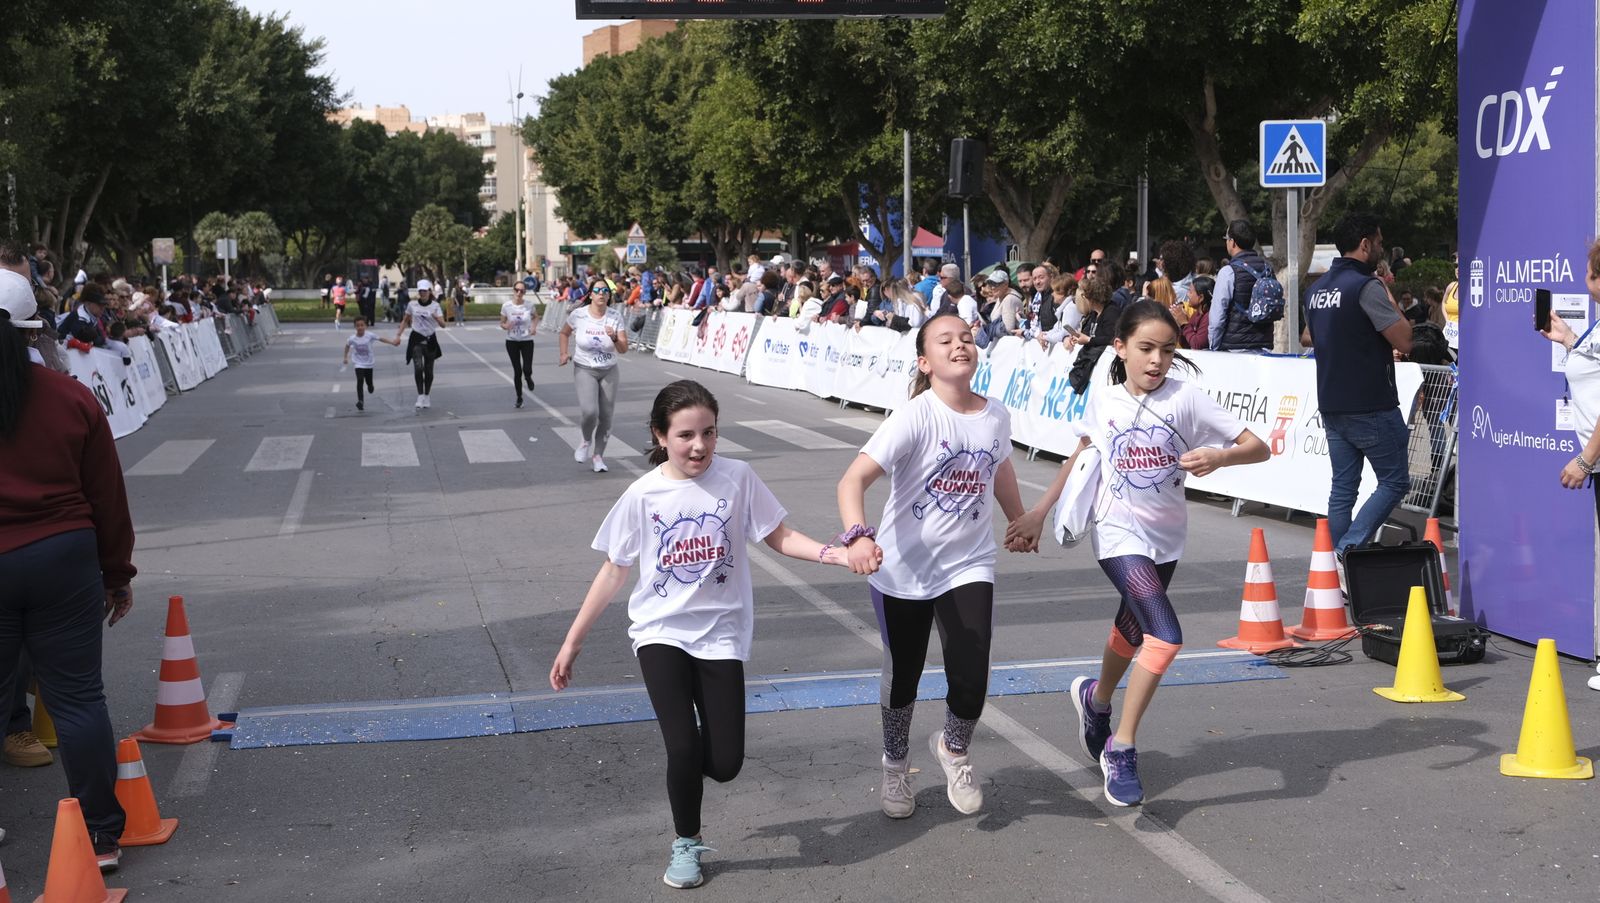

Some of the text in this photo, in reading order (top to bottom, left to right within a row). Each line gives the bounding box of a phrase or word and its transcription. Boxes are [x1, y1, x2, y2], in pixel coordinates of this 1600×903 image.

[1476, 80, 1558, 158] CDX
[1495, 253, 1574, 283] ALMERÍA
[1495, 288, 1533, 303] CIUDAD
[1207, 387, 1268, 424] MERÍA
[1127, 446, 1162, 457] MINI
[1116, 454, 1177, 470] RUNNER
[949, 470, 980, 482] MINI
[675, 535, 711, 552] MINI
[662, 546, 725, 566] RUNNER
